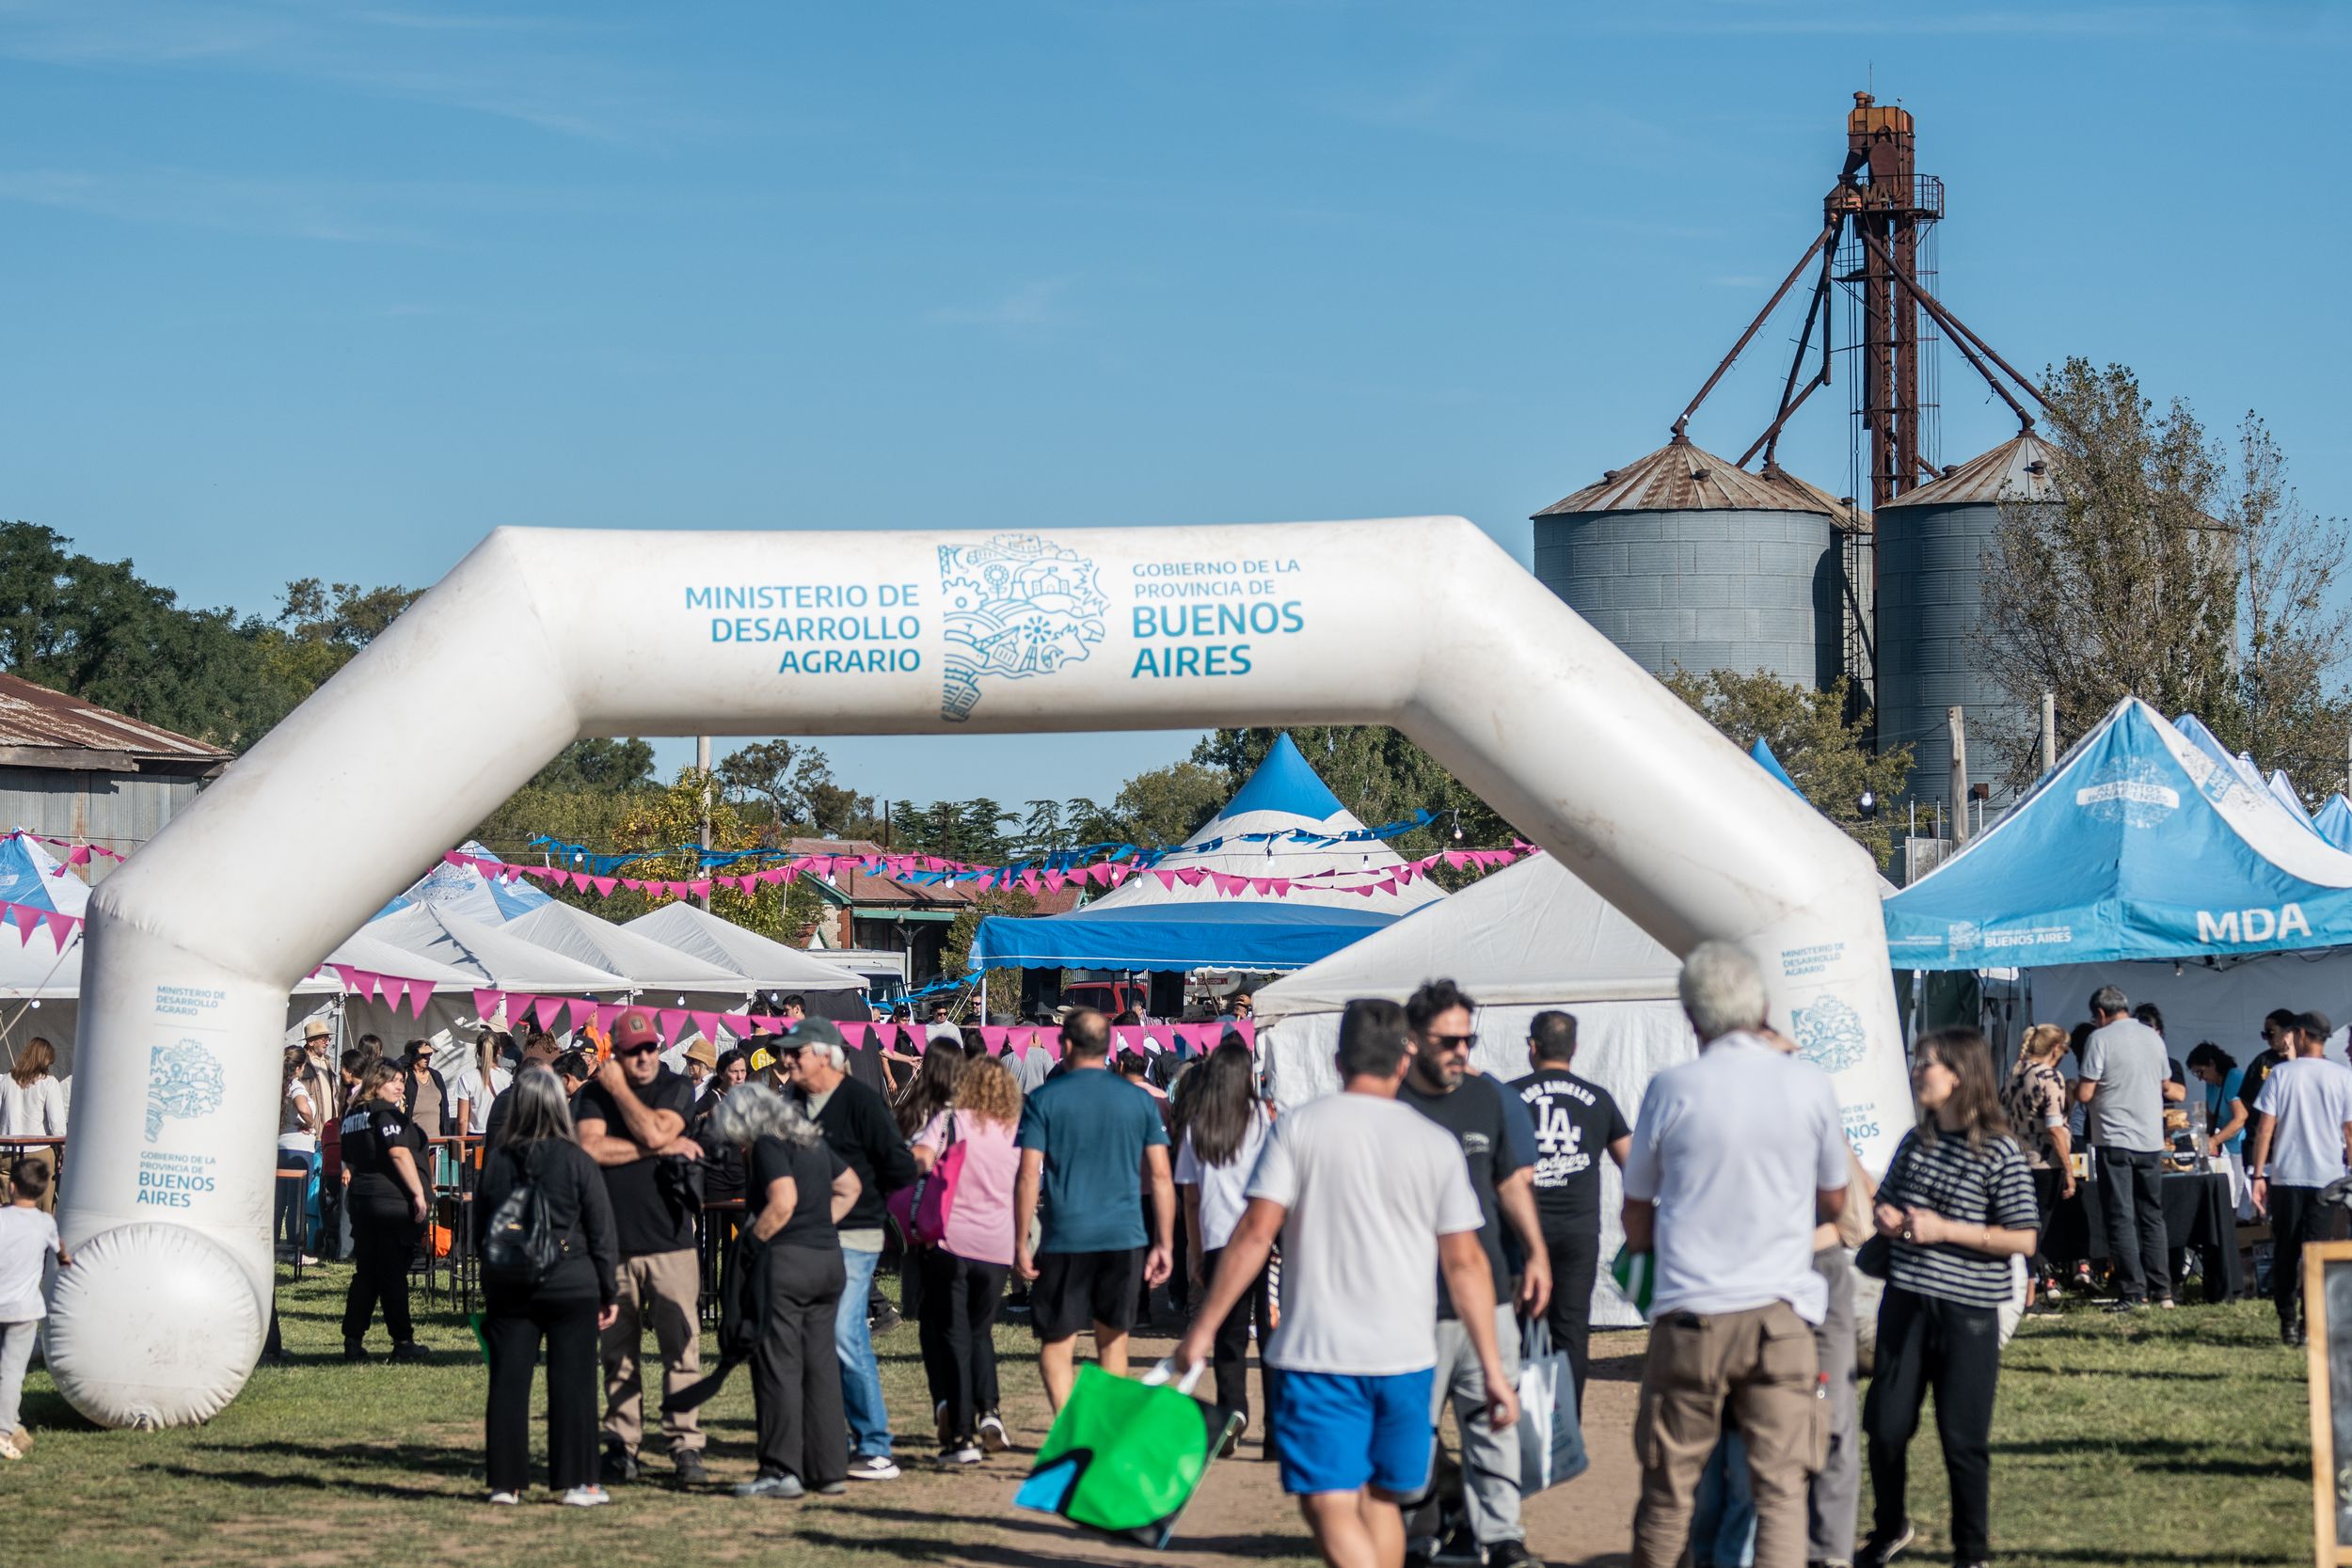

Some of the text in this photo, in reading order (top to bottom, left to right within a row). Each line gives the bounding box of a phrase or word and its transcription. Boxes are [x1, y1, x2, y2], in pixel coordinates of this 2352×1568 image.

[1133, 559, 1300, 577] GOBIERNO DE LA
[685, 584, 920, 610] MINISTERIO DE
[1135, 579, 1276, 598] PROVINCIA DE
[711, 615, 920, 642] DESARROLLO
[1132, 600, 1304, 638] BUENOS
[778, 648, 920, 673] AGRARIO
[1130, 643, 1251, 678] AIRES
[2197, 902, 2312, 944] MDA
[1984, 935, 2034, 948] BUENOS
[2037, 931, 2072, 944] AIRES
[156, 995, 218, 1008] DESARROLLO
[157, 986, 226, 1000] MINISTERIO DE
[155, 1005, 198, 1016] AGRARIO
[1520, 1081, 1596, 1106] LOS ANGELES
[1534, 1096, 1581, 1154] LA
[1846, 1122, 1880, 1140] NOS
[140, 1151, 188, 1163] GOBIERNO
[140, 1161, 189, 1173] PROVINCIA
[1534, 1150, 1591, 1178] odgers
[139, 1171, 215, 1192] BUENOS
[136, 1189, 191, 1208] AIRES
